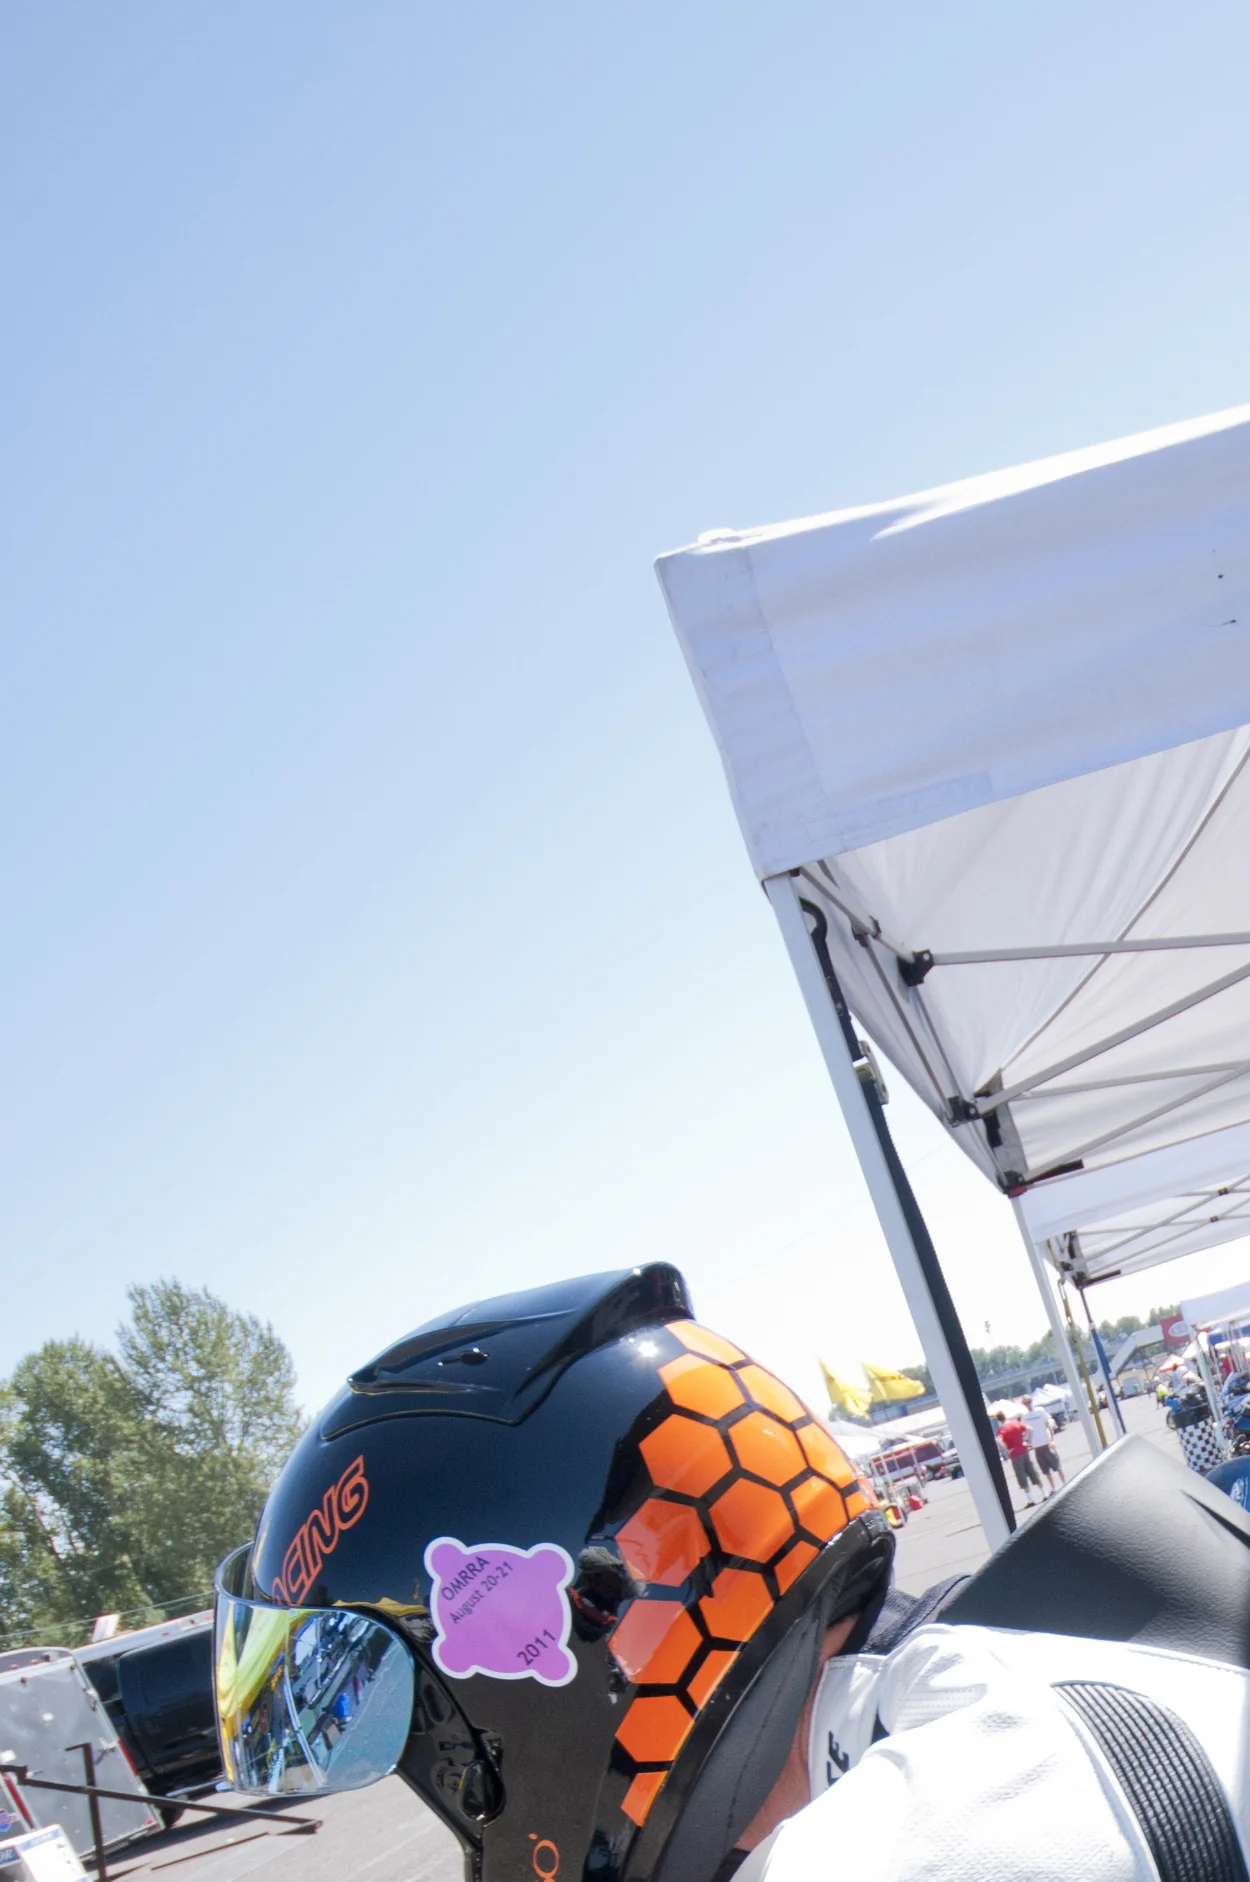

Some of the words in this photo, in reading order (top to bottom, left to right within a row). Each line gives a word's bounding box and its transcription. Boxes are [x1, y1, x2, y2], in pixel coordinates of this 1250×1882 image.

[441, 1556, 490, 1601] OMRRA
[449, 1590, 485, 1624] August
[481, 1562, 514, 1592] 20-21
[517, 1629, 556, 1666] 2011
